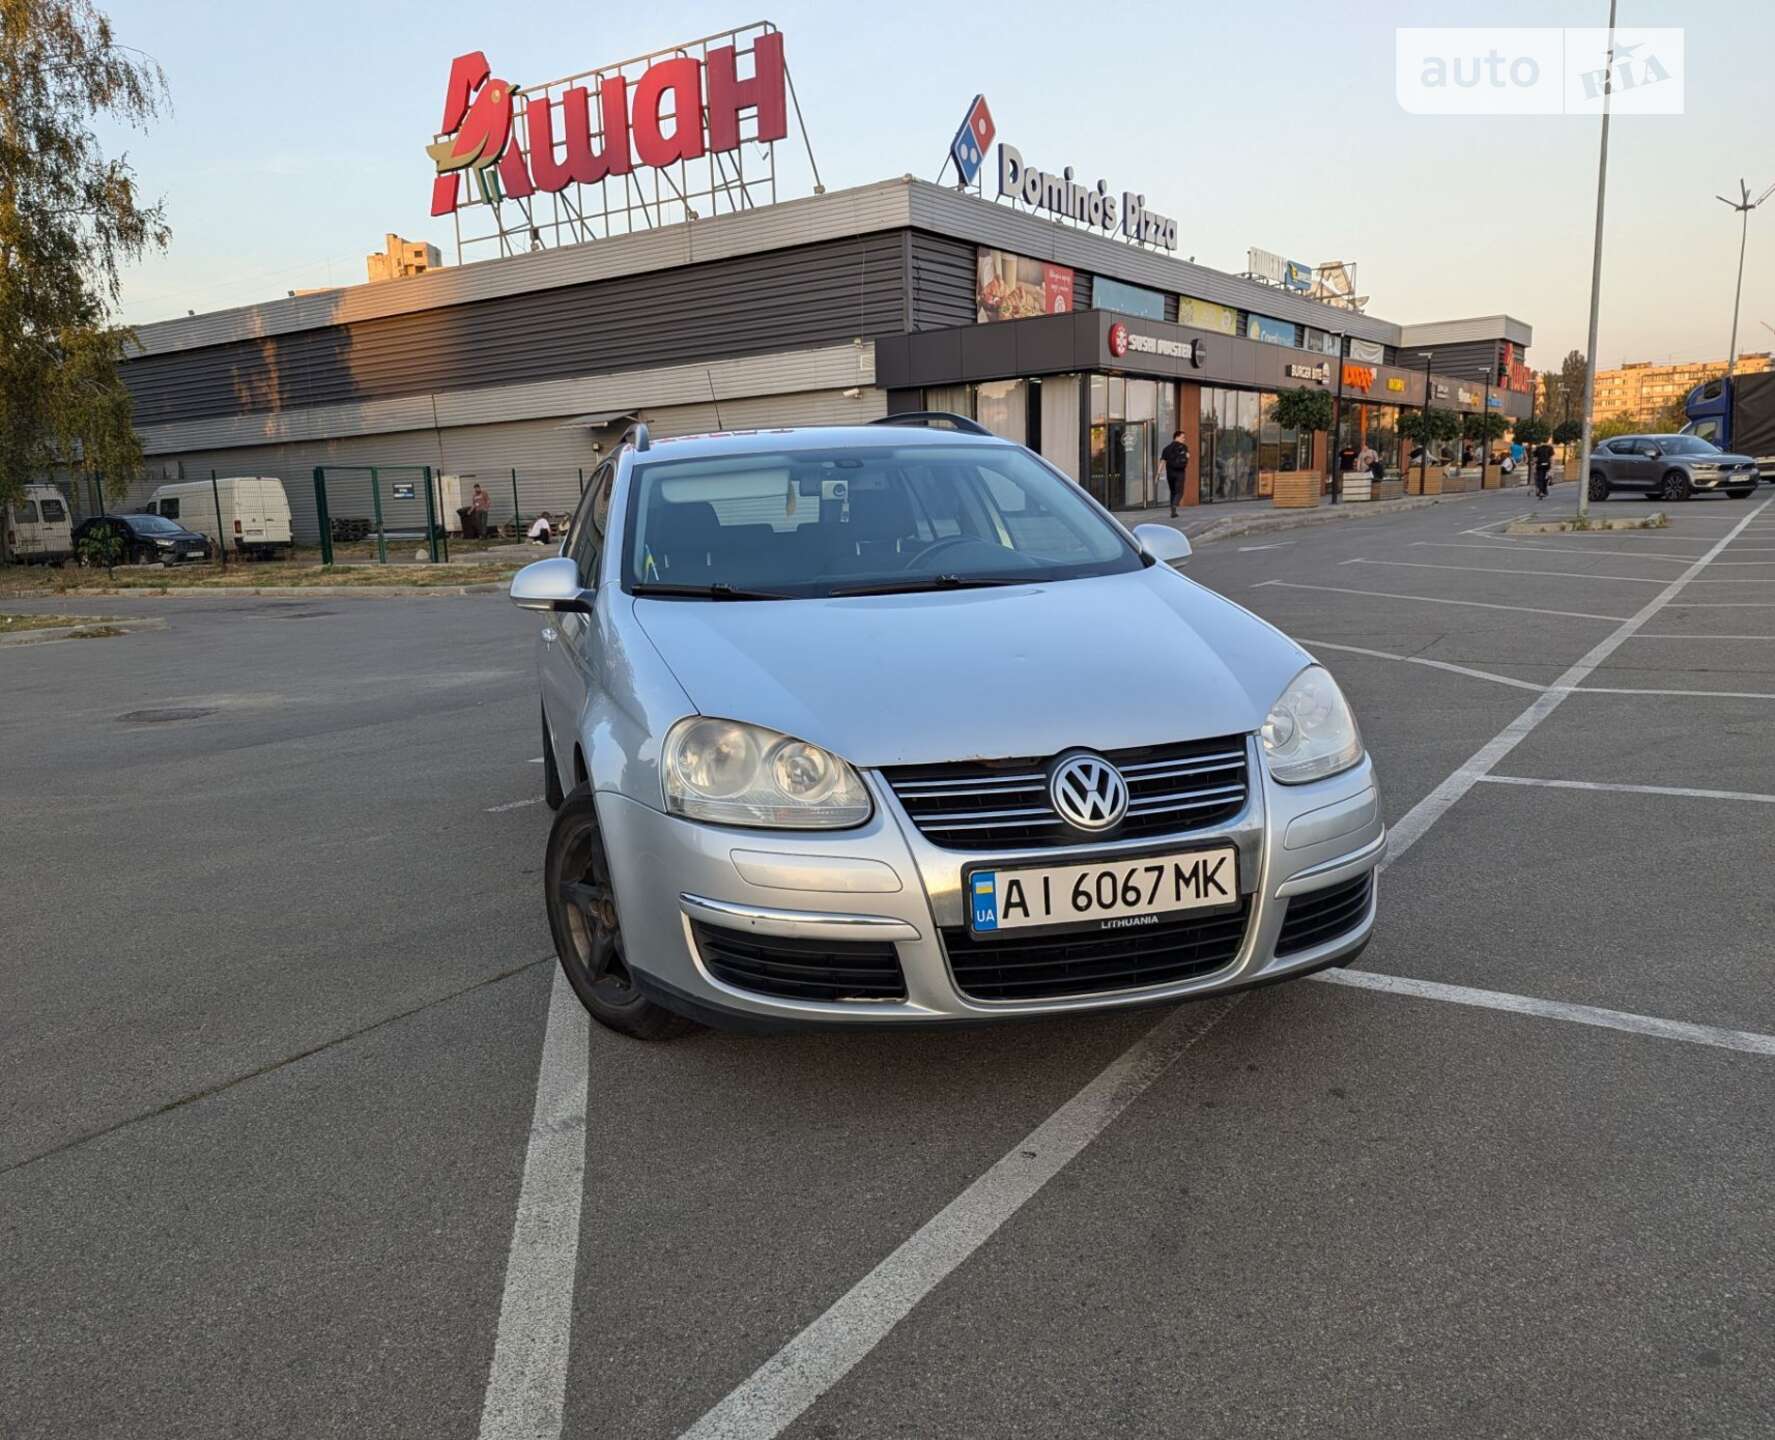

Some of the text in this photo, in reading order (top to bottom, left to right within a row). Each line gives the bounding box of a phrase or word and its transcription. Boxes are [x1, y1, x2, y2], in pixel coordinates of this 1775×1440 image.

[998, 143, 1178, 251] Domino's Pizza
[1128, 334, 1157, 353] SUSHI
[1002, 856, 1228, 920] AI 6067 MK
[976, 909, 995, 922] UA
[1101, 915, 1159, 929] LITHUANIA
